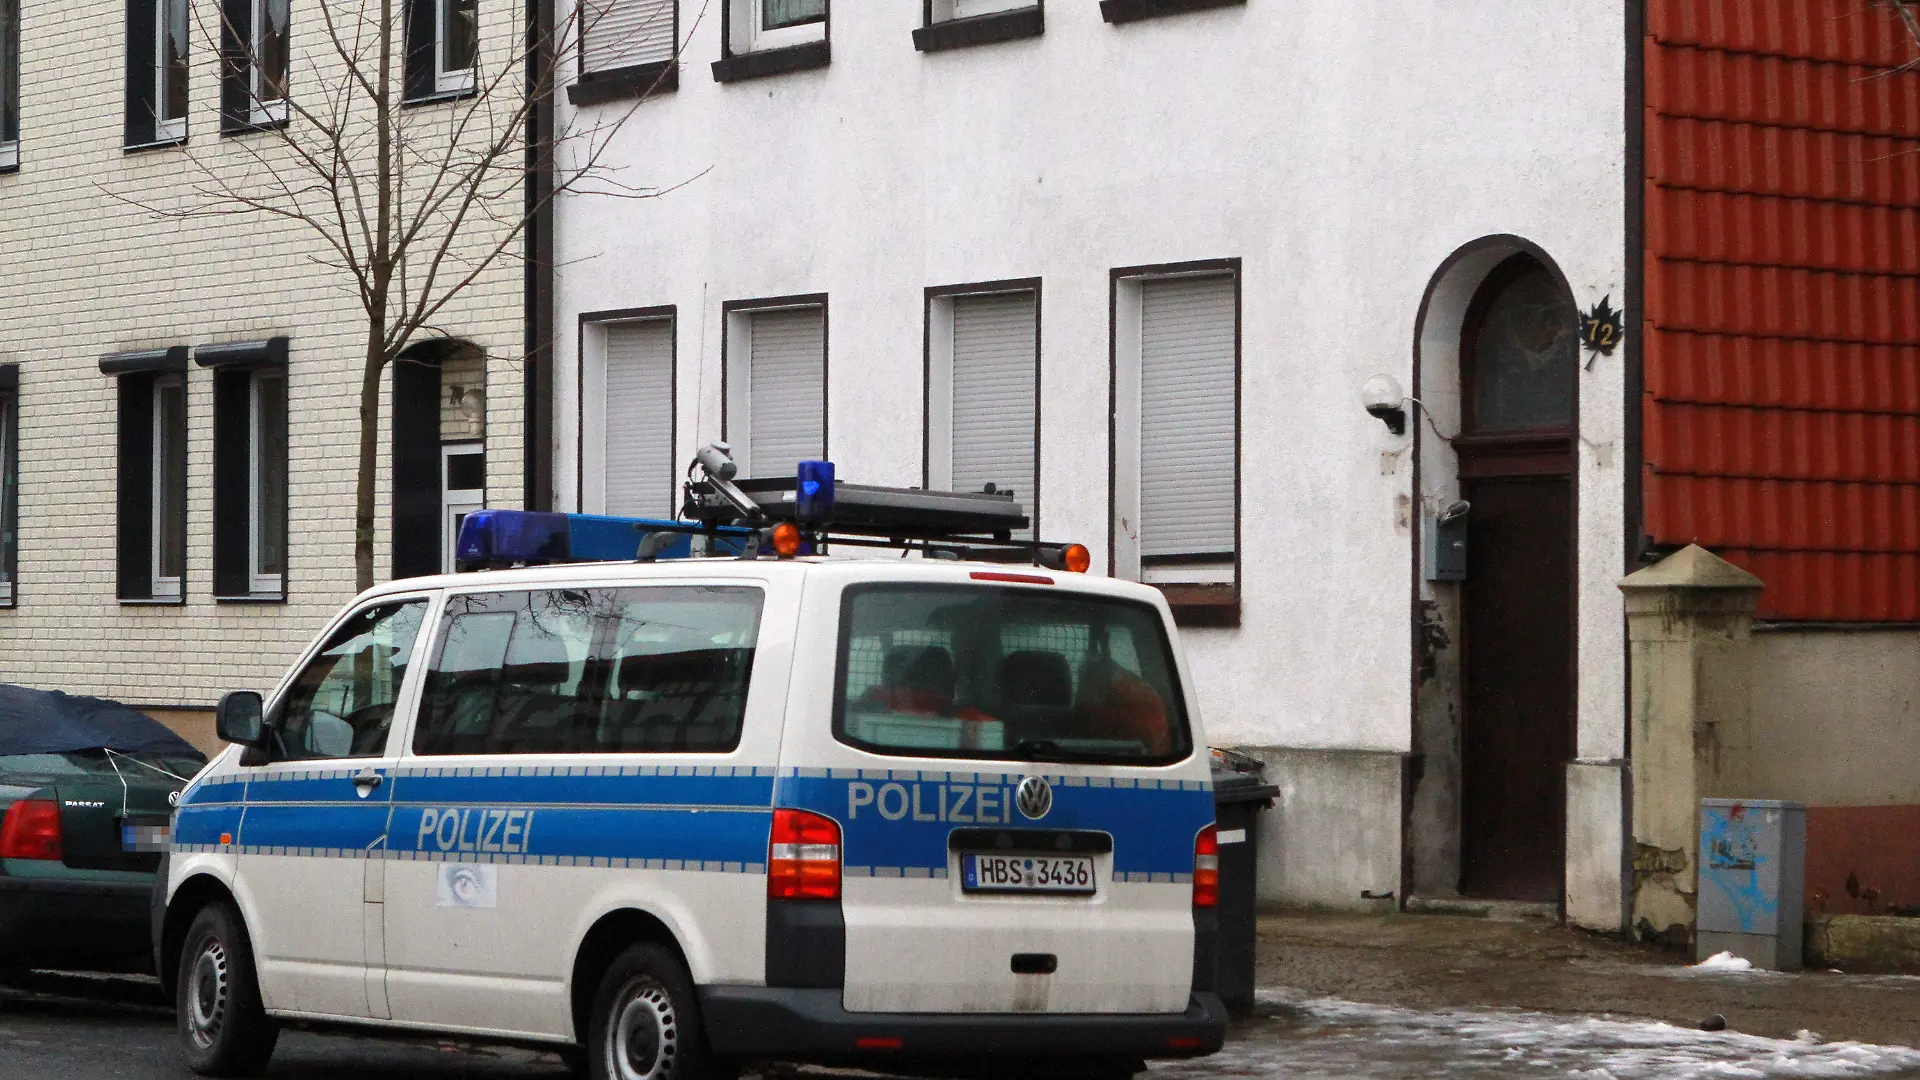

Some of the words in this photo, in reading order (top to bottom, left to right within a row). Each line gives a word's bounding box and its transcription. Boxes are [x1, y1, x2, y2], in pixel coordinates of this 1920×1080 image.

[1587, 319, 1613, 345] 72
[849, 782, 1010, 824] POLIZEI
[418, 808, 534, 853] POLIZEI
[980, 858, 1022, 884] HBS
[1037, 859, 1088, 886] 3436
